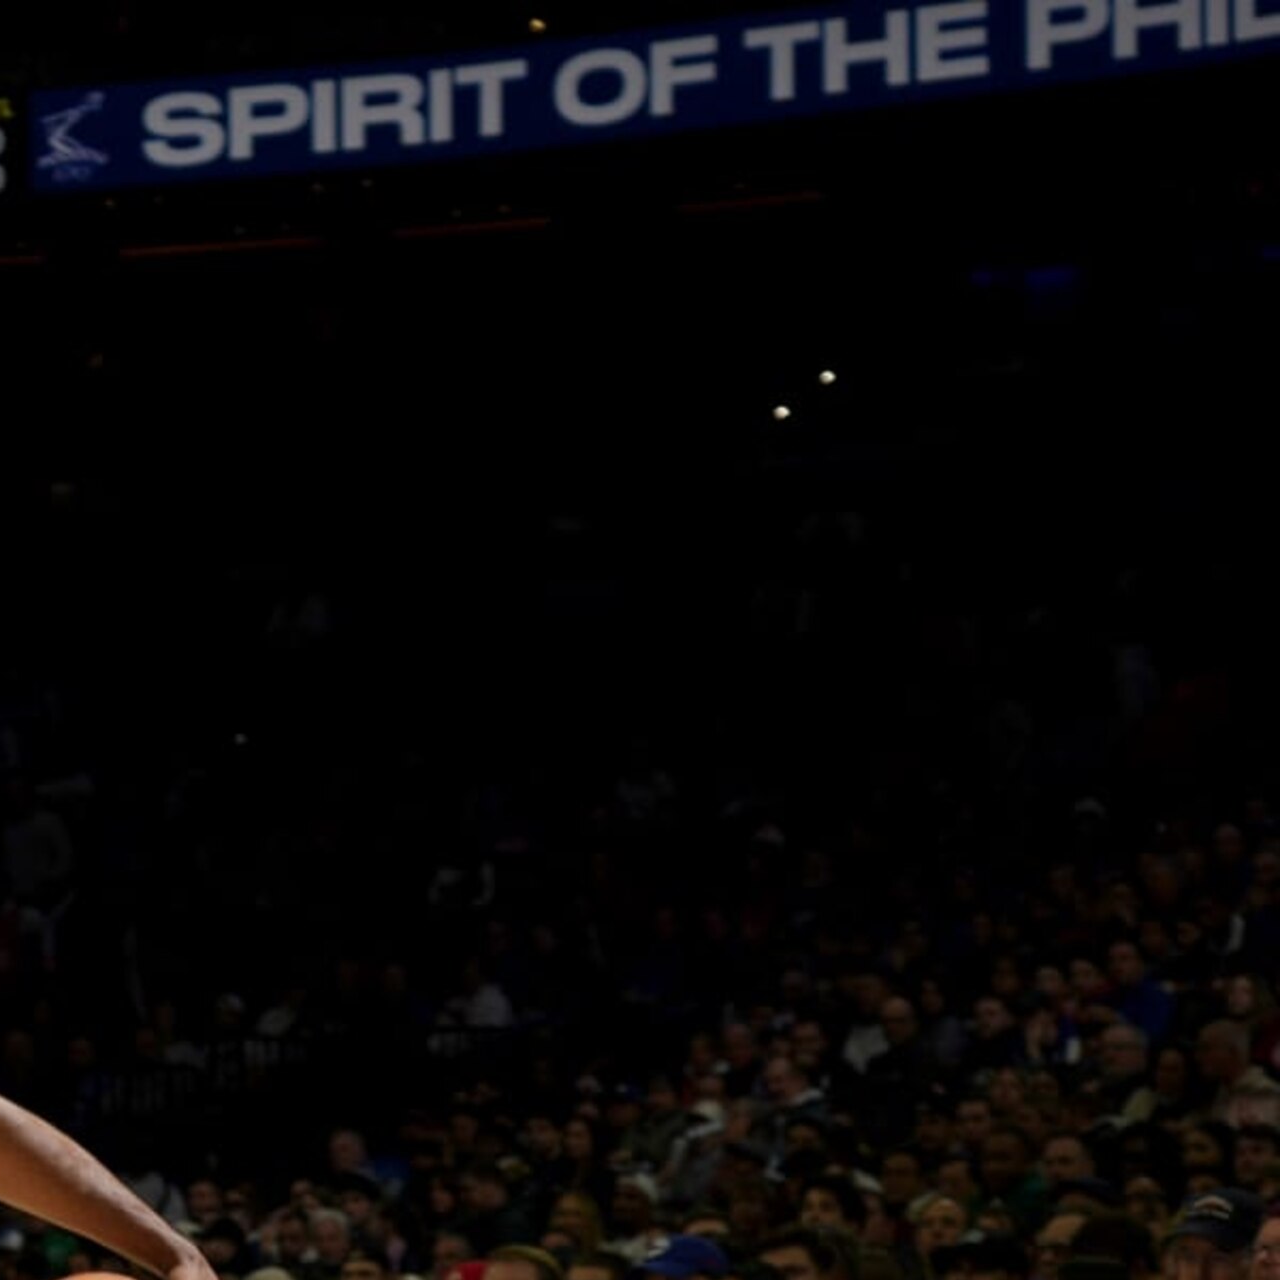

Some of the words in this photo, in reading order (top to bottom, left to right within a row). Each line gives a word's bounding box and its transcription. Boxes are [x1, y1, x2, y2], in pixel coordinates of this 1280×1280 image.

[142, 60, 527, 168] SPIRIT
[553, 34, 718, 126] OF
[744, 0, 990, 101] THE
